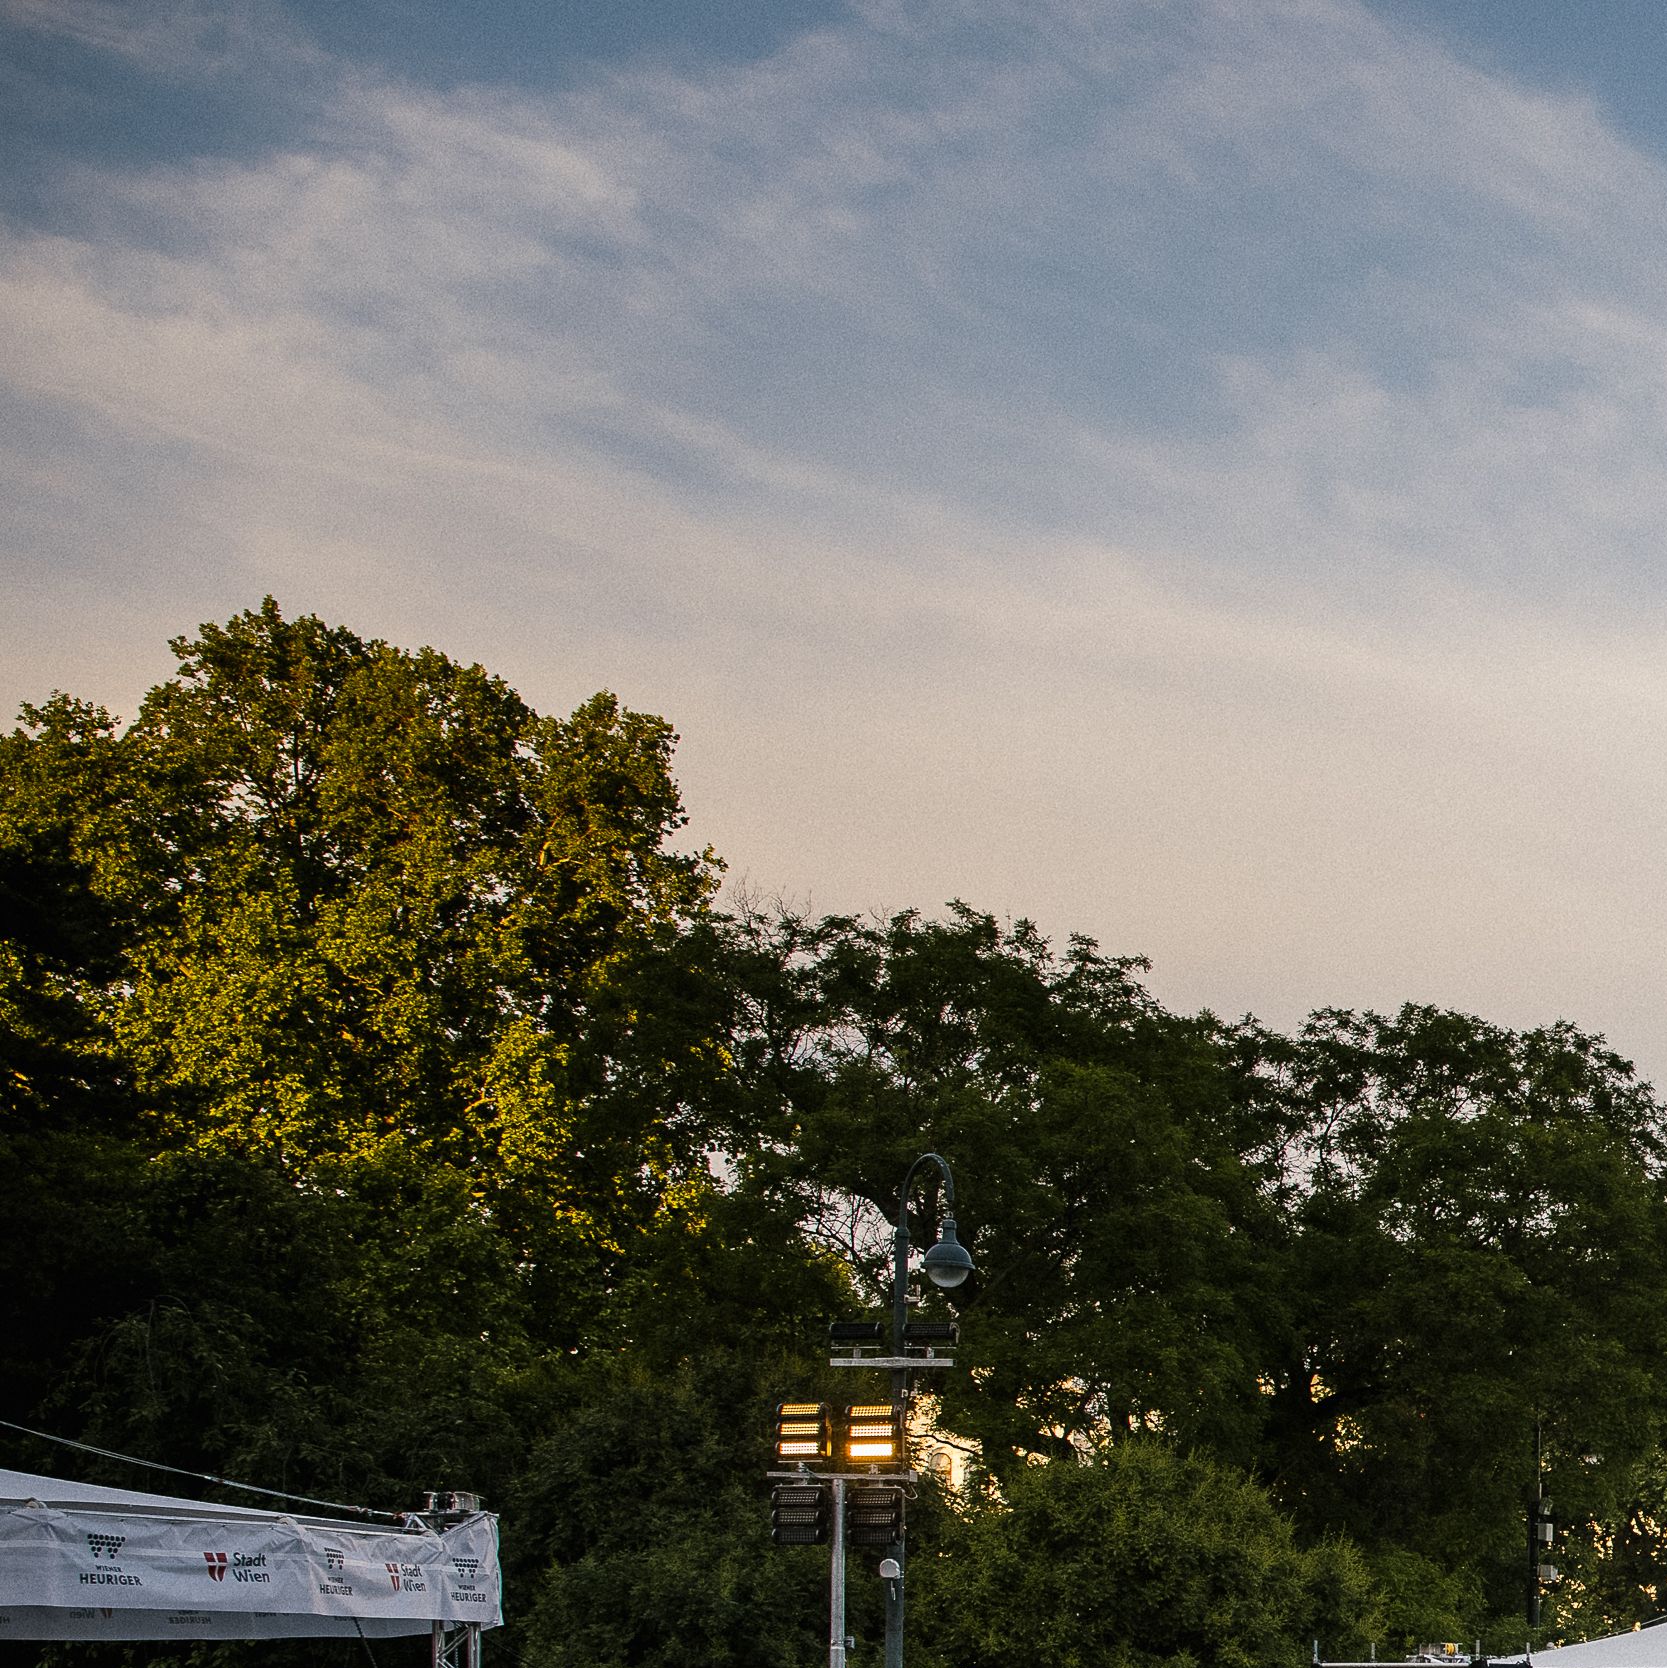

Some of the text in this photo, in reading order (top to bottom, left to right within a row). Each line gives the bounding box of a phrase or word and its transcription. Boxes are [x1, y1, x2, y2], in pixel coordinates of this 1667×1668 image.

[233, 1552, 266, 1568] Stadt
[96, 1565, 122, 1573] WIENER
[402, 1564, 421, 1577] Stadt
[80, 1573, 142, 1587] HEURIGER
[233, 1569, 270, 1583] Wien
[320, 1584, 353, 1597] HEURIGER
[403, 1579, 426, 1593] Wien
[451, 1592, 487, 1603] HEURIGER
